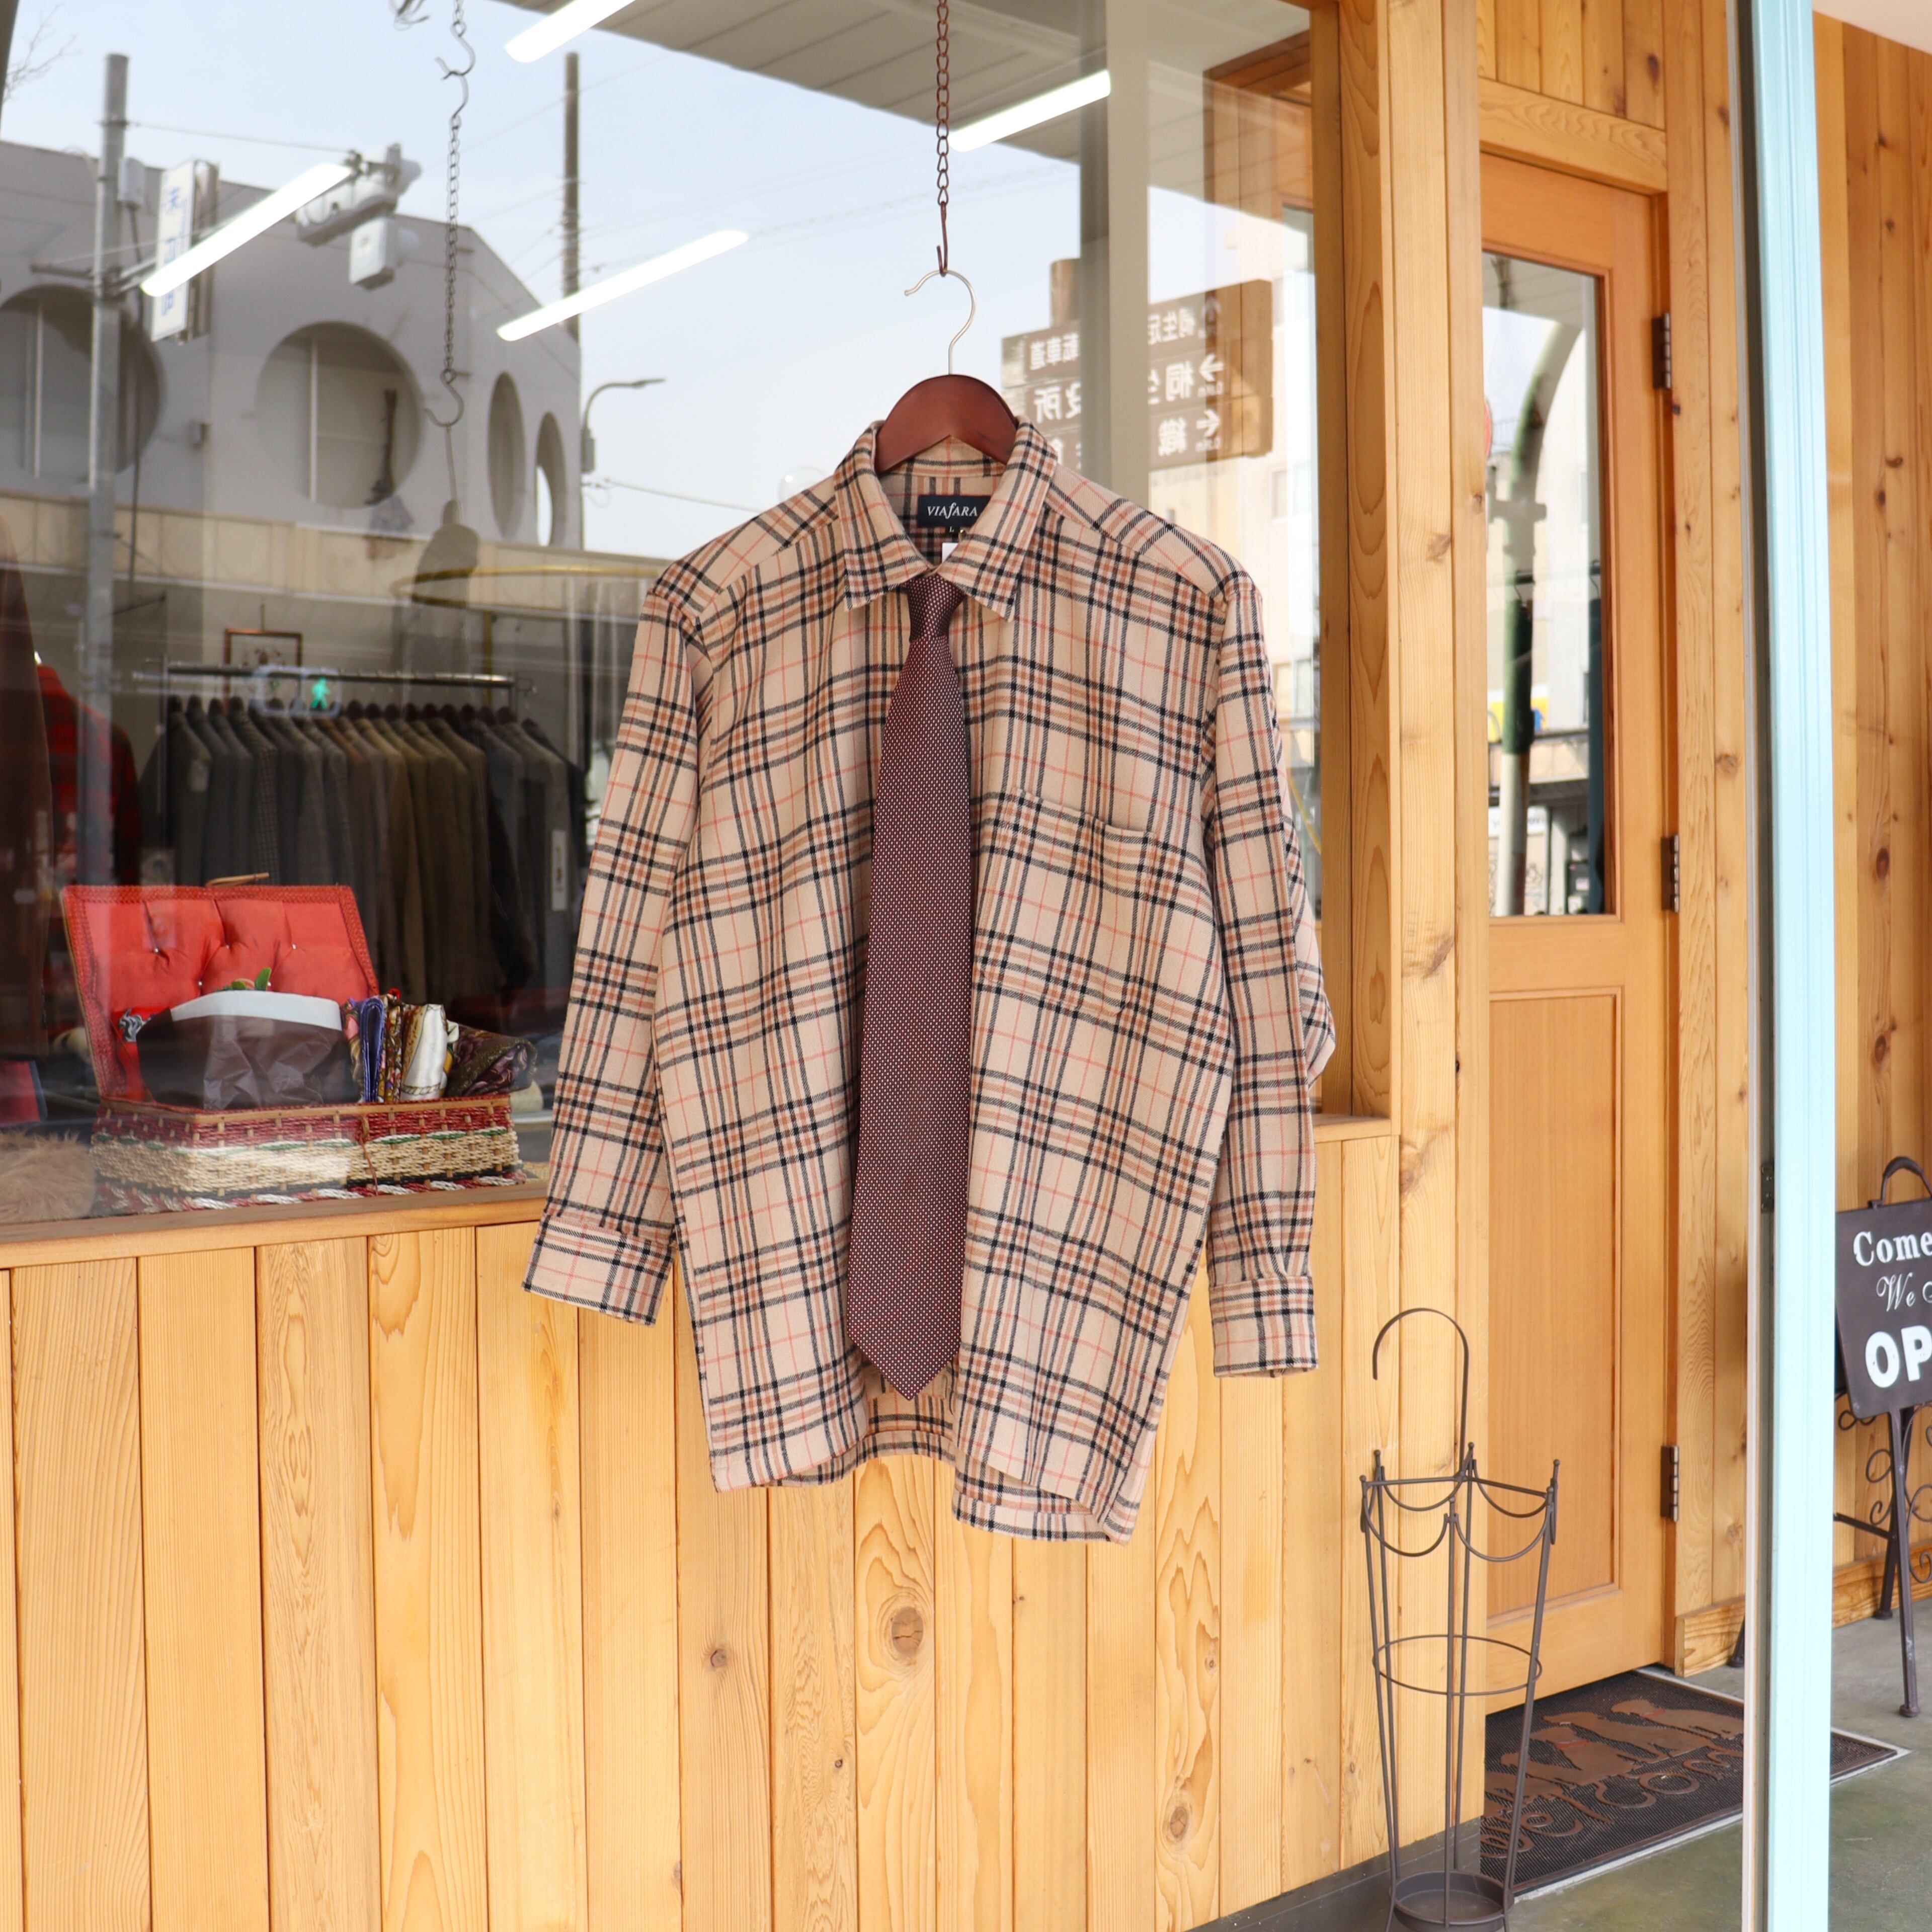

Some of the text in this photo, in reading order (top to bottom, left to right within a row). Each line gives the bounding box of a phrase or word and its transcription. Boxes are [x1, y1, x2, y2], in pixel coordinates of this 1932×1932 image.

[1853, 1231, 1932, 1266] Come
[1876, 1272, 1915, 1312] We
[1865, 1325, 1932, 1388] OP
